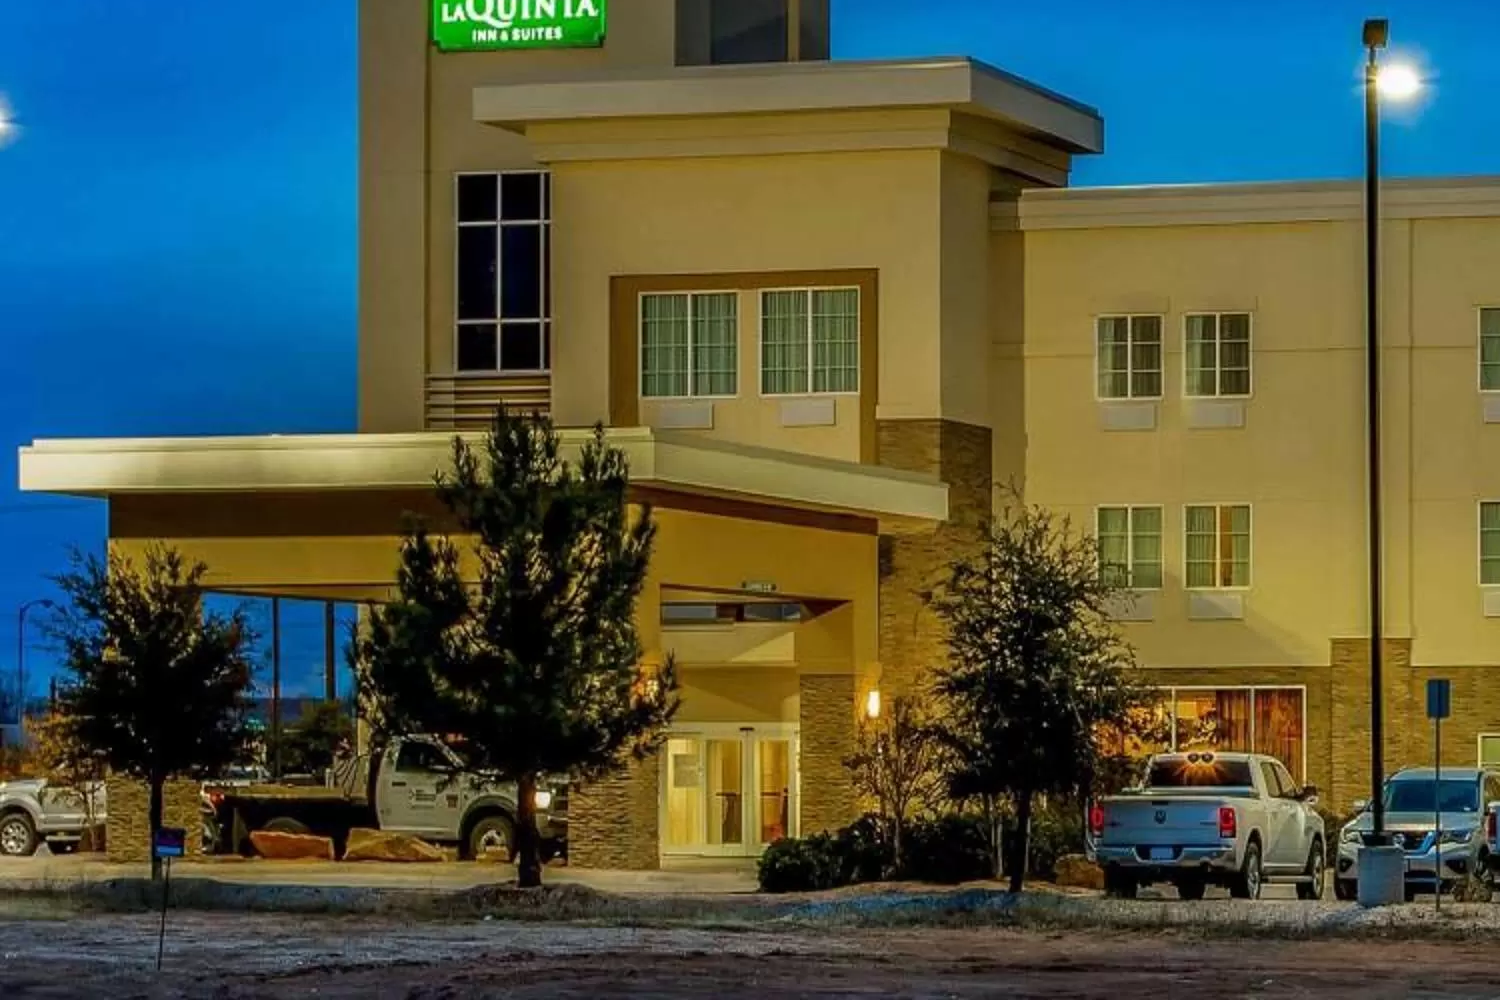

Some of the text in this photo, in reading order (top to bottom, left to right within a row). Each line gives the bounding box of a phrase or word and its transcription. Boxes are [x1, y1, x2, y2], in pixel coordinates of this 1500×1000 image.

[442, 3, 466, 22] LA
[472, 29, 497, 42] INN
[512, 26, 562, 41] SUITES
